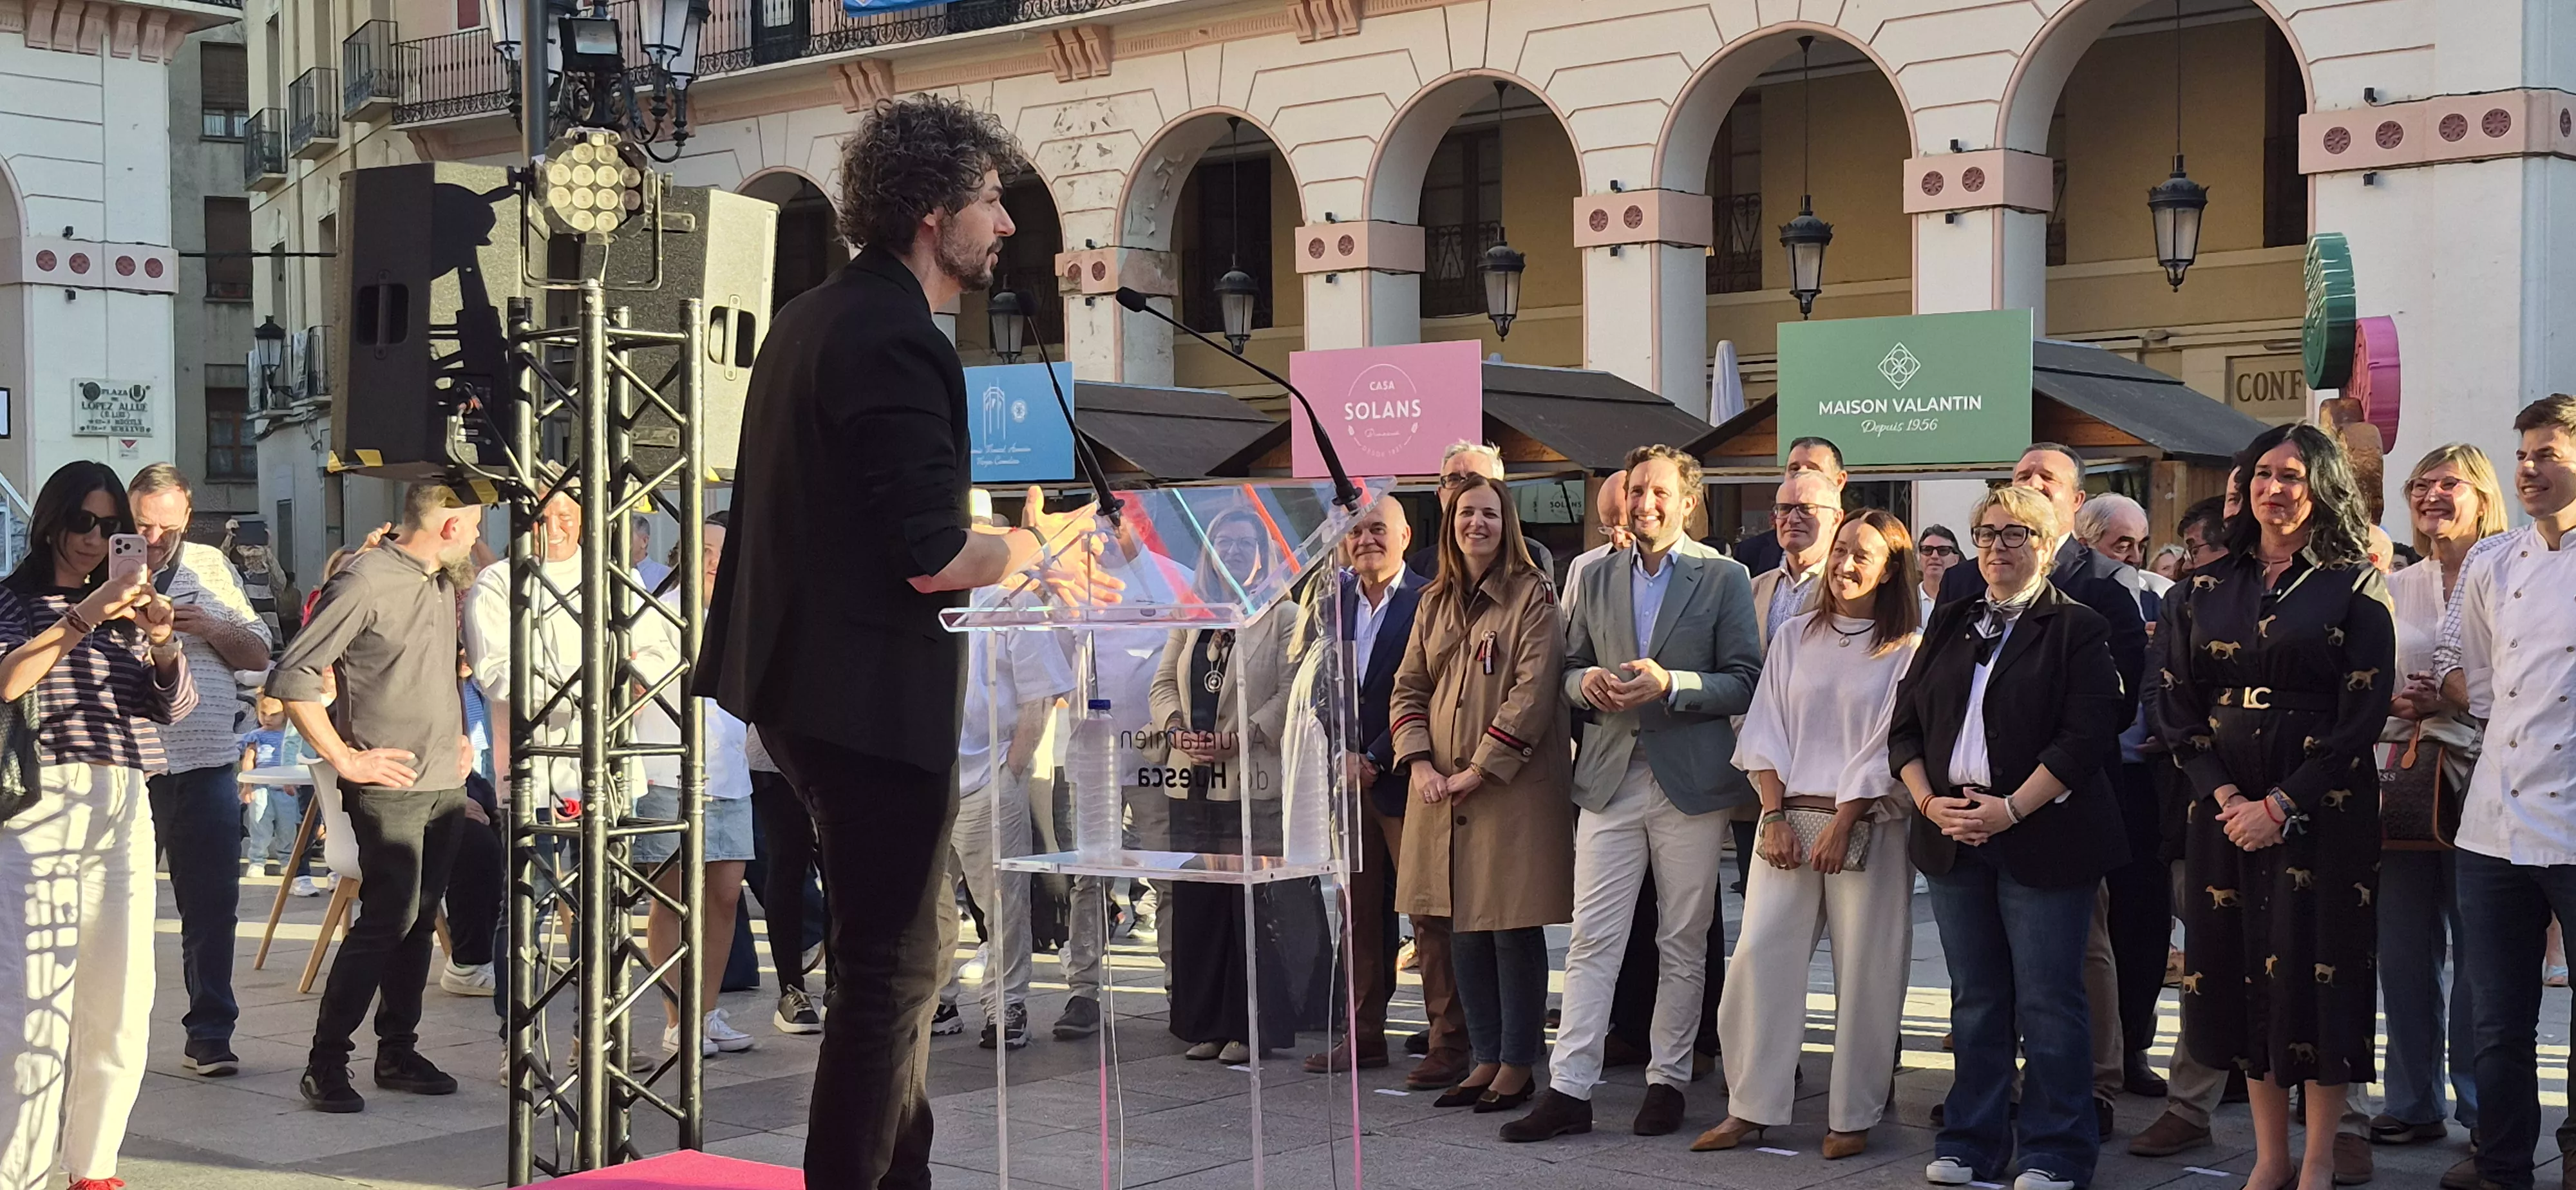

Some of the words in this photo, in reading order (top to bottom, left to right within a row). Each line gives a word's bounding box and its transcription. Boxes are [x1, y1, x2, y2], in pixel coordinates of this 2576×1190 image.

[1369, 381, 1395, 391] CASA
[1345, 399, 1422, 420] SOLANS
[1819, 399, 1888, 416] MAISON
[1892, 395, 1982, 413] VALANTIN
[1861, 419, 1904, 438] Depuis
[1906, 418, 1939, 432] 1956
[2242, 686, 2273, 709] LC
